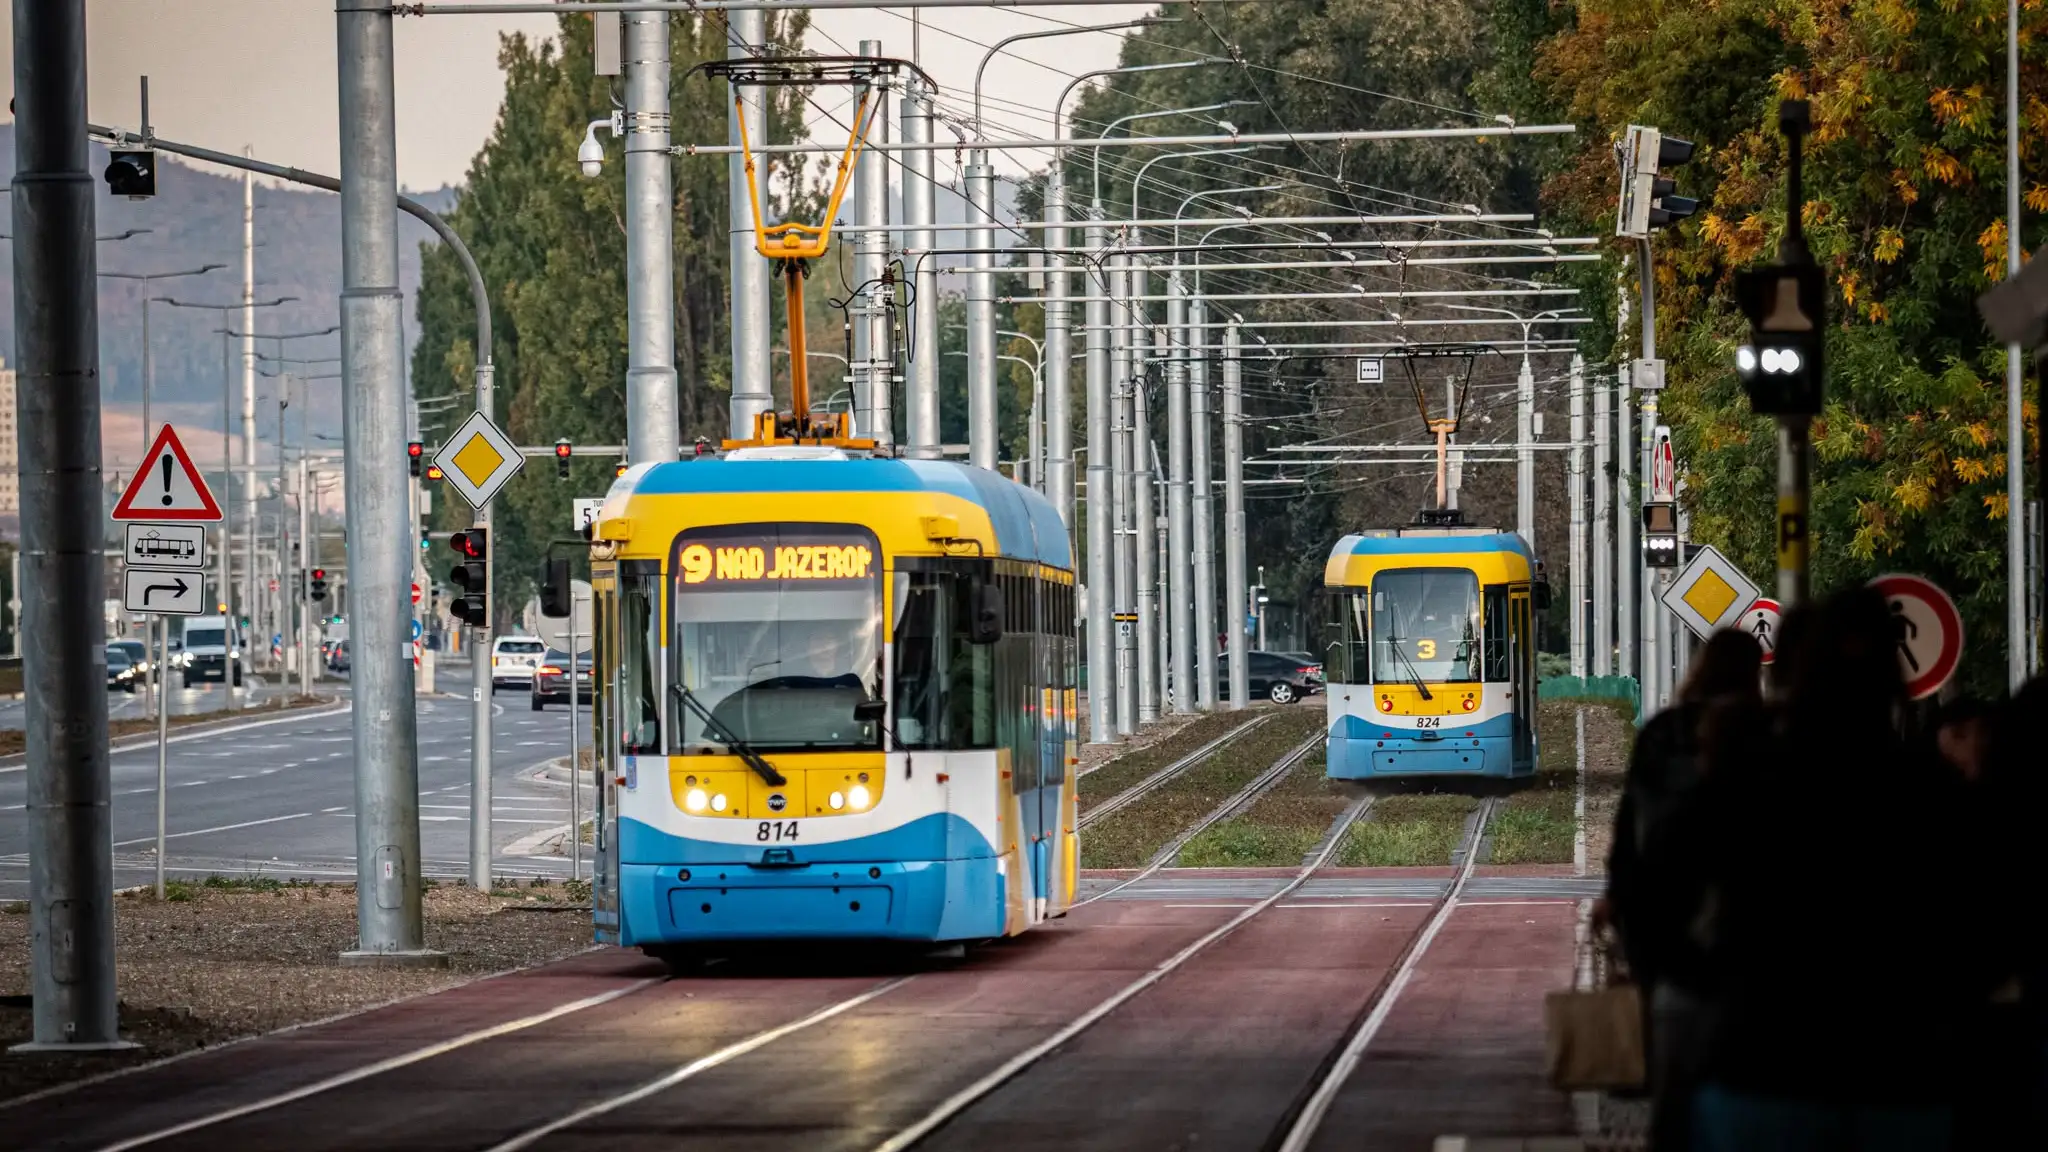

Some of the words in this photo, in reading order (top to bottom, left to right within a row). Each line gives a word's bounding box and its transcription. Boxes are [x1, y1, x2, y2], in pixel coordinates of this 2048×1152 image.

[681, 544, 712, 583] 9
[716, 547, 764, 579] NAD
[1417, 639, 1436, 659] 3
[1416, 717, 1440, 728] 824
[757, 821, 799, 841] 814
